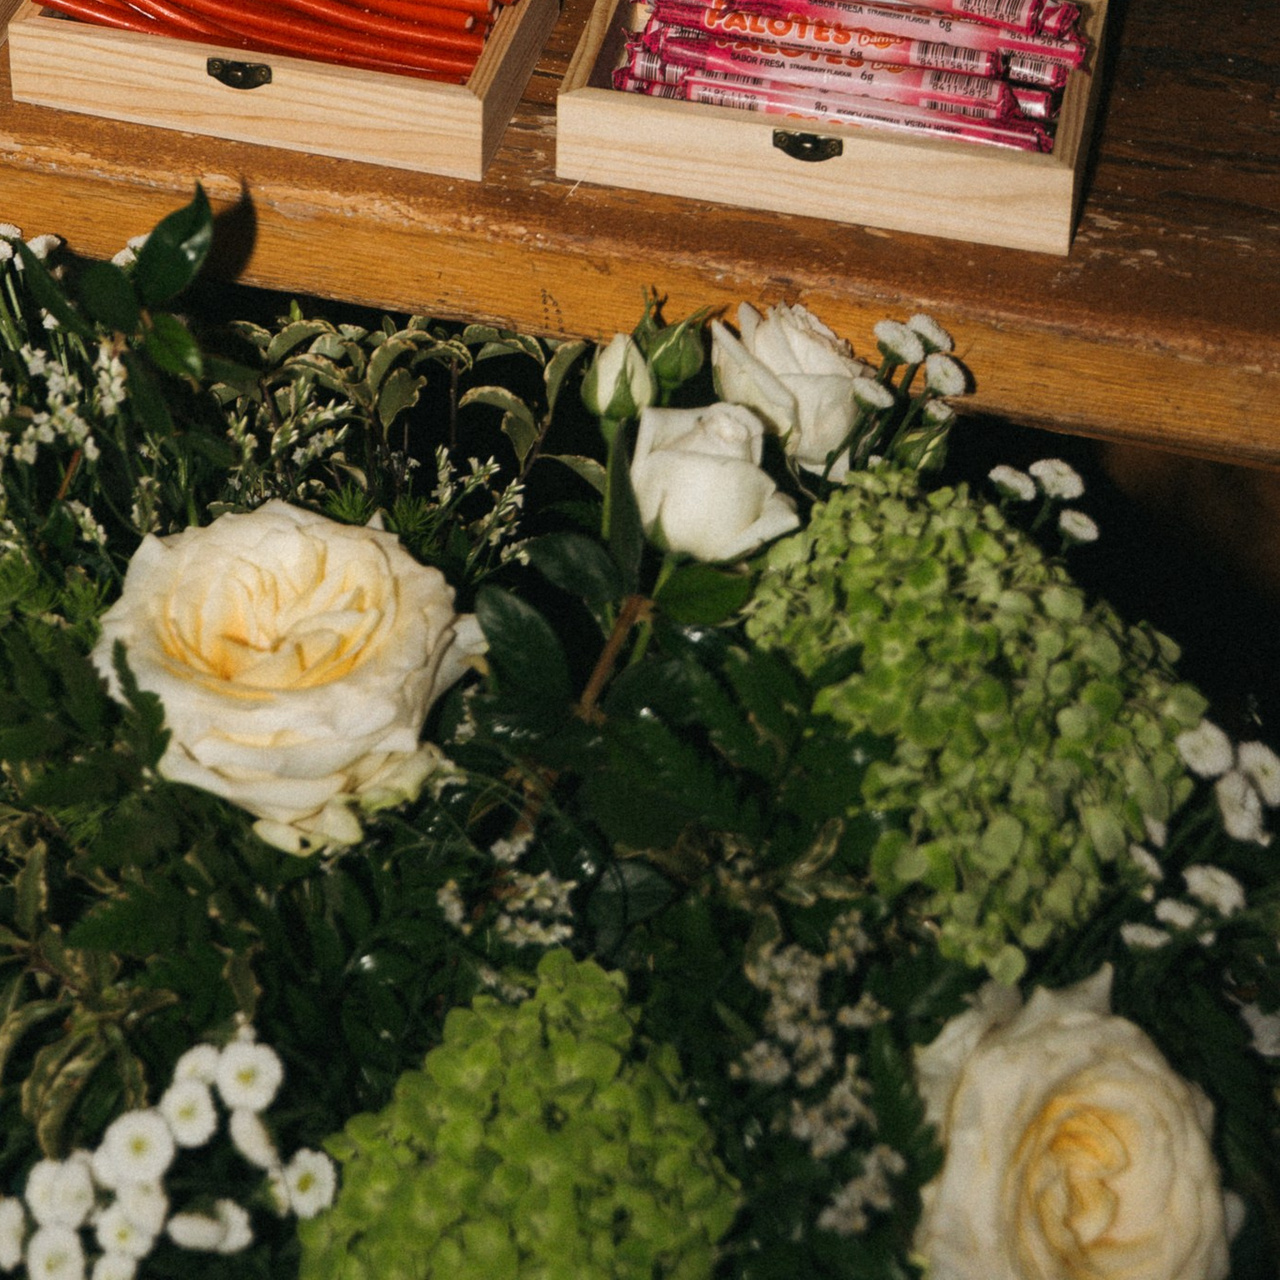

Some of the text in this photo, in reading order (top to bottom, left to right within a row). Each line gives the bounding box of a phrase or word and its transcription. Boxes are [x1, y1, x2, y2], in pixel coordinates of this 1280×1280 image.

[705, 9, 851, 44] PALOTES
[837, 2, 863, 15] FRESA
[938, 18, 952, 32] 6g
[731, 52, 758, 65] SABOR
[760, 57, 785, 69] FRESA
[860, 70, 874, 82] 6g
